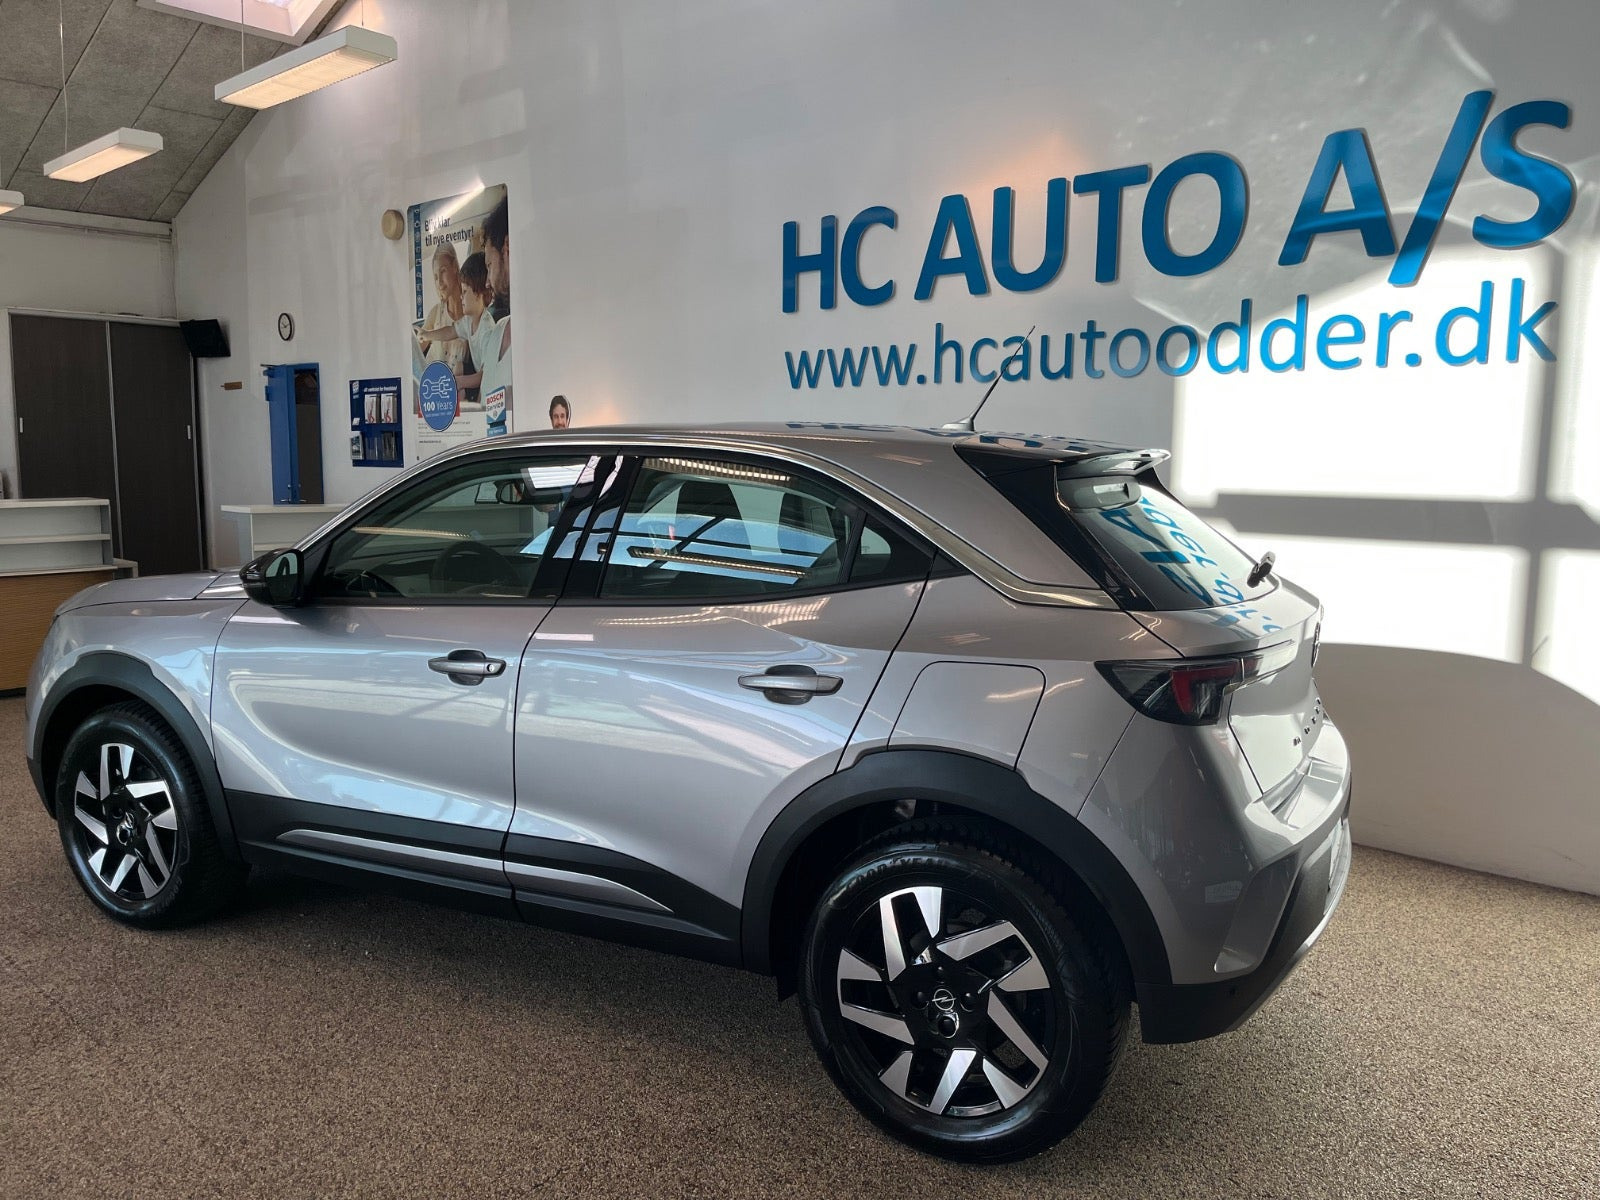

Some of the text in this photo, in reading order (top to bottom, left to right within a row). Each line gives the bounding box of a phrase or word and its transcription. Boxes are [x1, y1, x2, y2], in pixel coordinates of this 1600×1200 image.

[782, 89, 1578, 314] HC AUTO A/S
[425, 225, 475, 247] til nye eventyr!
[784, 277, 1559, 390] www.hcautoodder.dk
[423, 401, 454, 412] 100 Years
[486, 392, 504, 405] BOSCH
